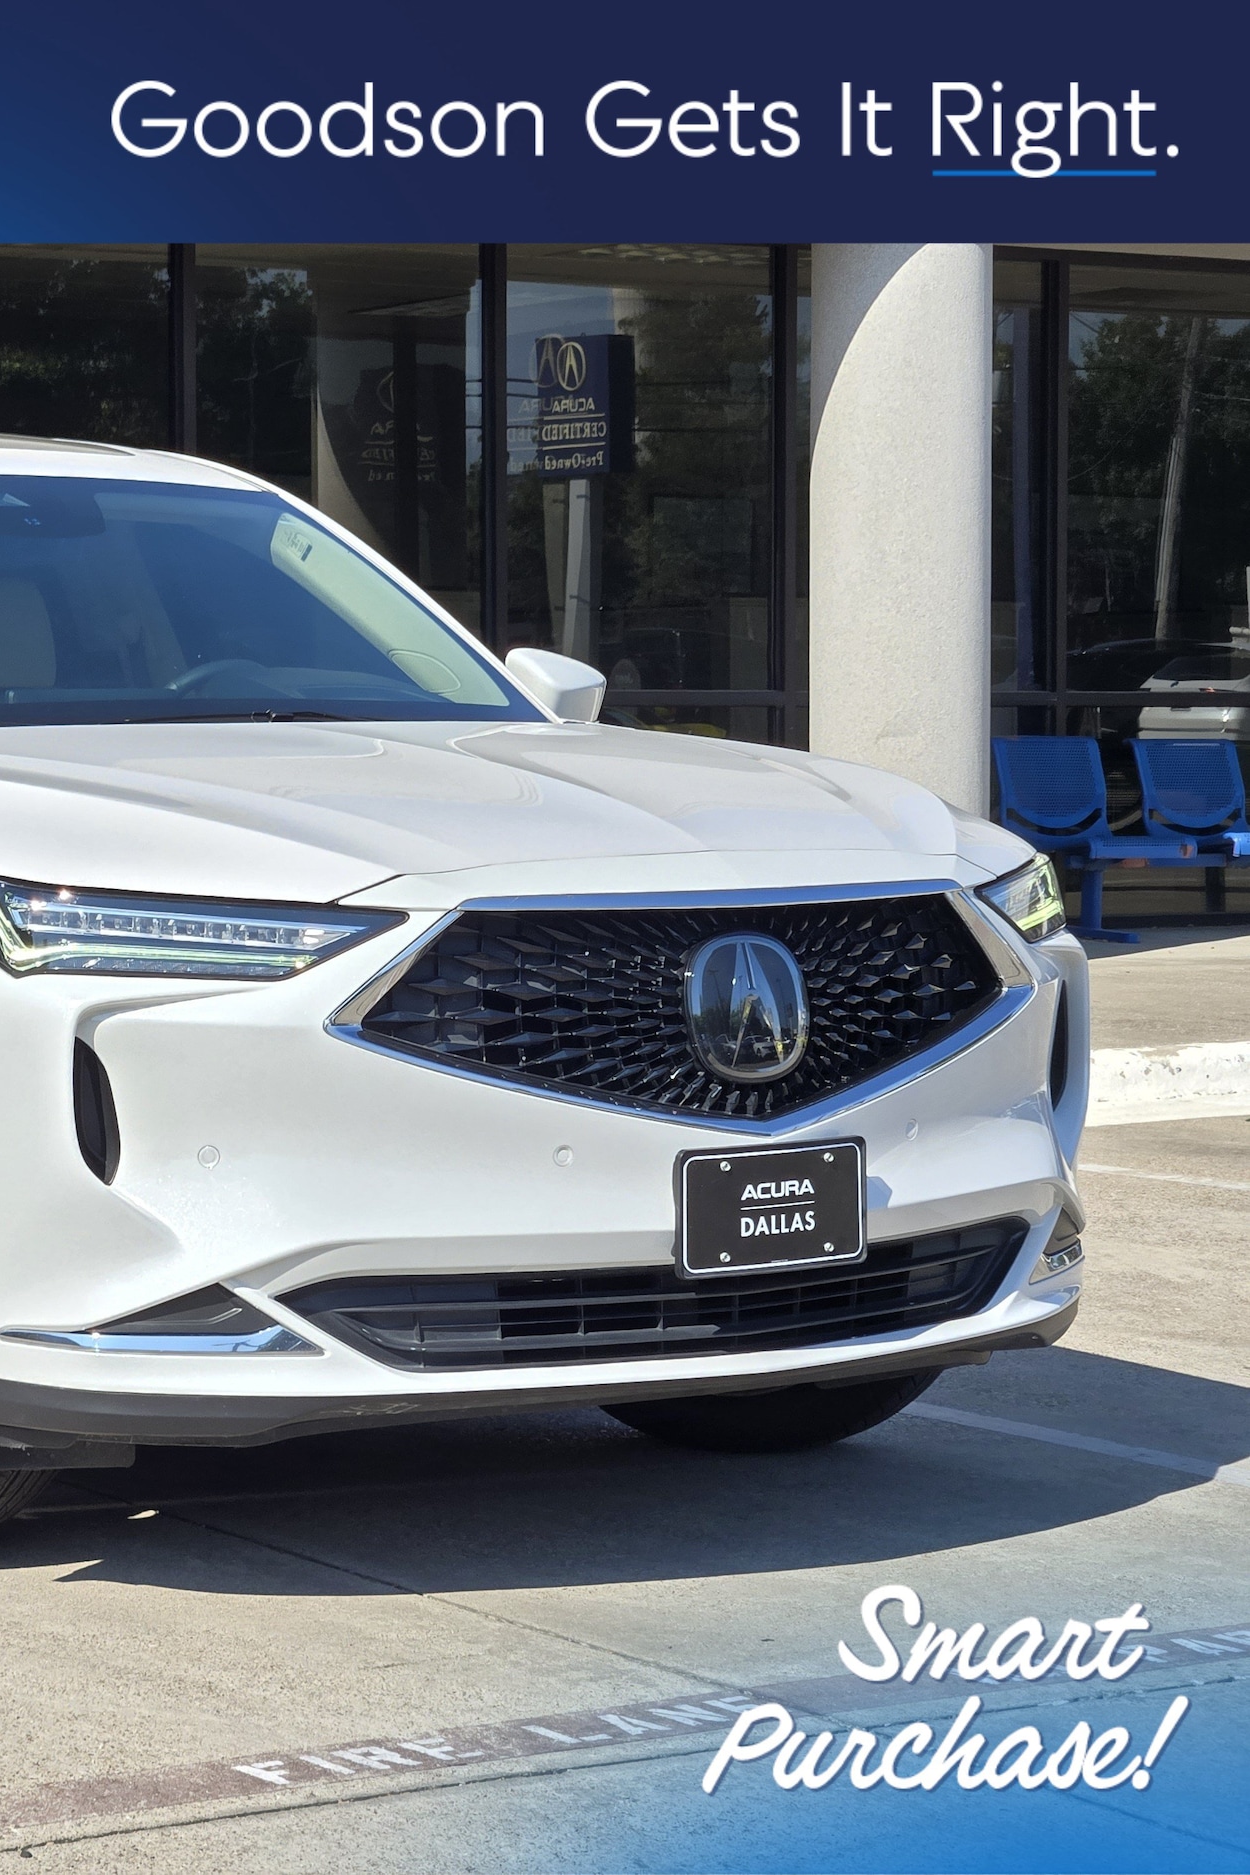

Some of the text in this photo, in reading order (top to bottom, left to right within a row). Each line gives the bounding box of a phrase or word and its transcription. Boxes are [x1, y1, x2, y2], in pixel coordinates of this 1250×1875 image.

[740, 1178, 815, 1201] ACURA
[740, 1210, 816, 1238] DALLAS
[232, 1695, 761, 1786] FIRE LANE
